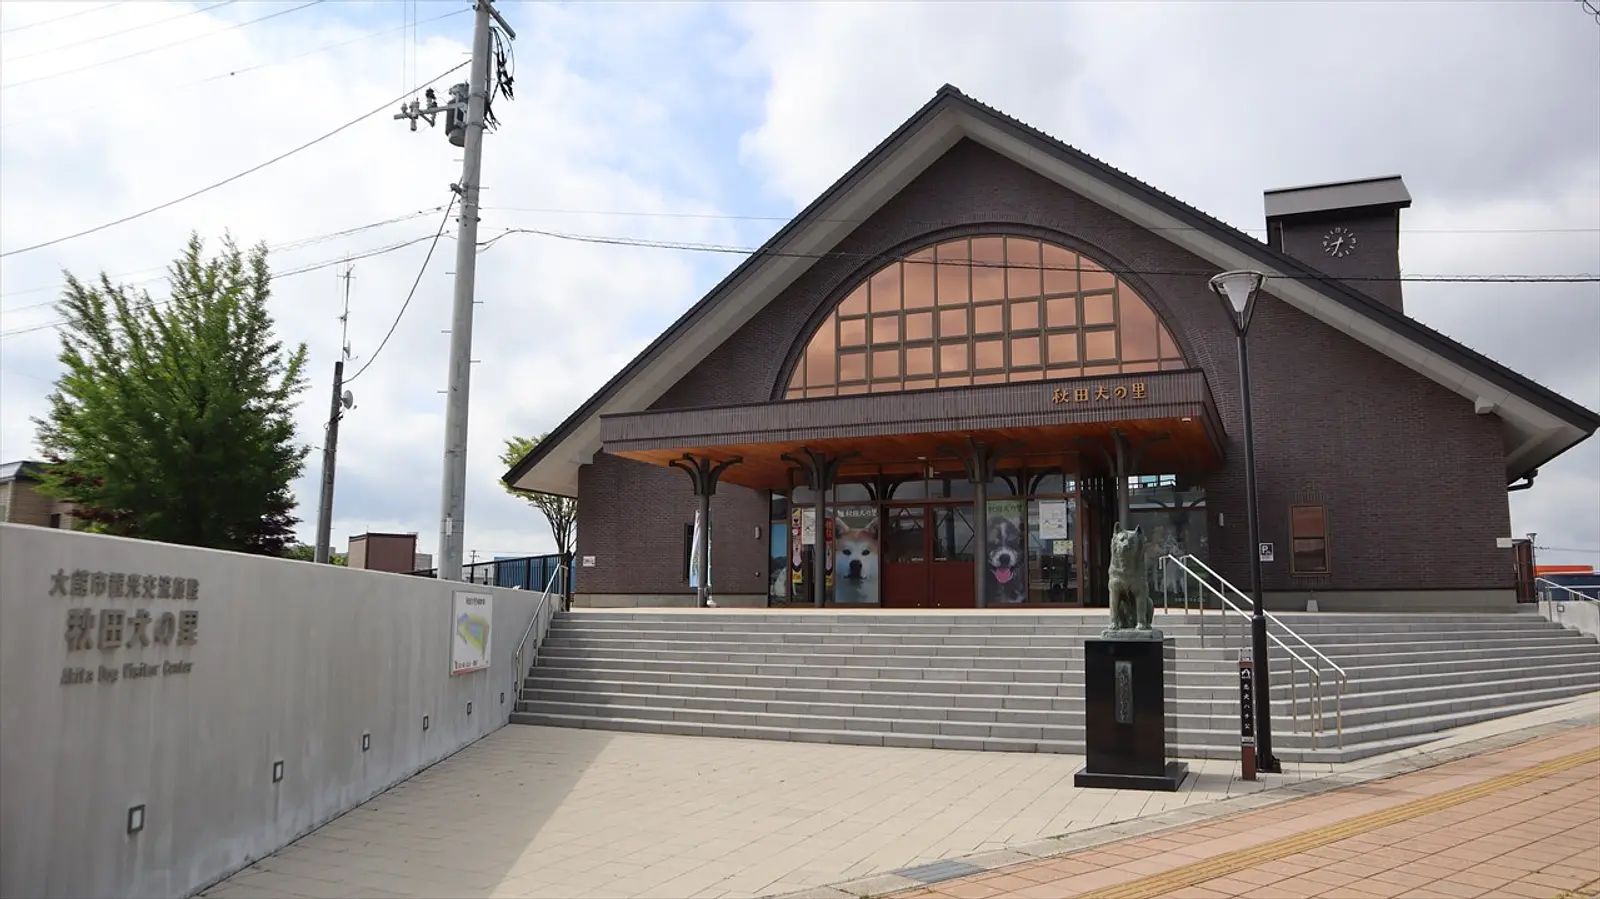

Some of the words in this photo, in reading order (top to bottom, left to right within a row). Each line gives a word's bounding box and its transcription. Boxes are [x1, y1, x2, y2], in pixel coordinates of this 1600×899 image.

[1052, 382, 1147, 404] 秋田犬の里
[1262, 545, 1268, 554] P
[64, 607, 200, 652] 秋田犬の里
[60, 666, 94, 686] Akita
[97, 665, 121, 684] Dog
[122, 662, 160, 680] Visitor
[162, 660, 194, 677] Center
